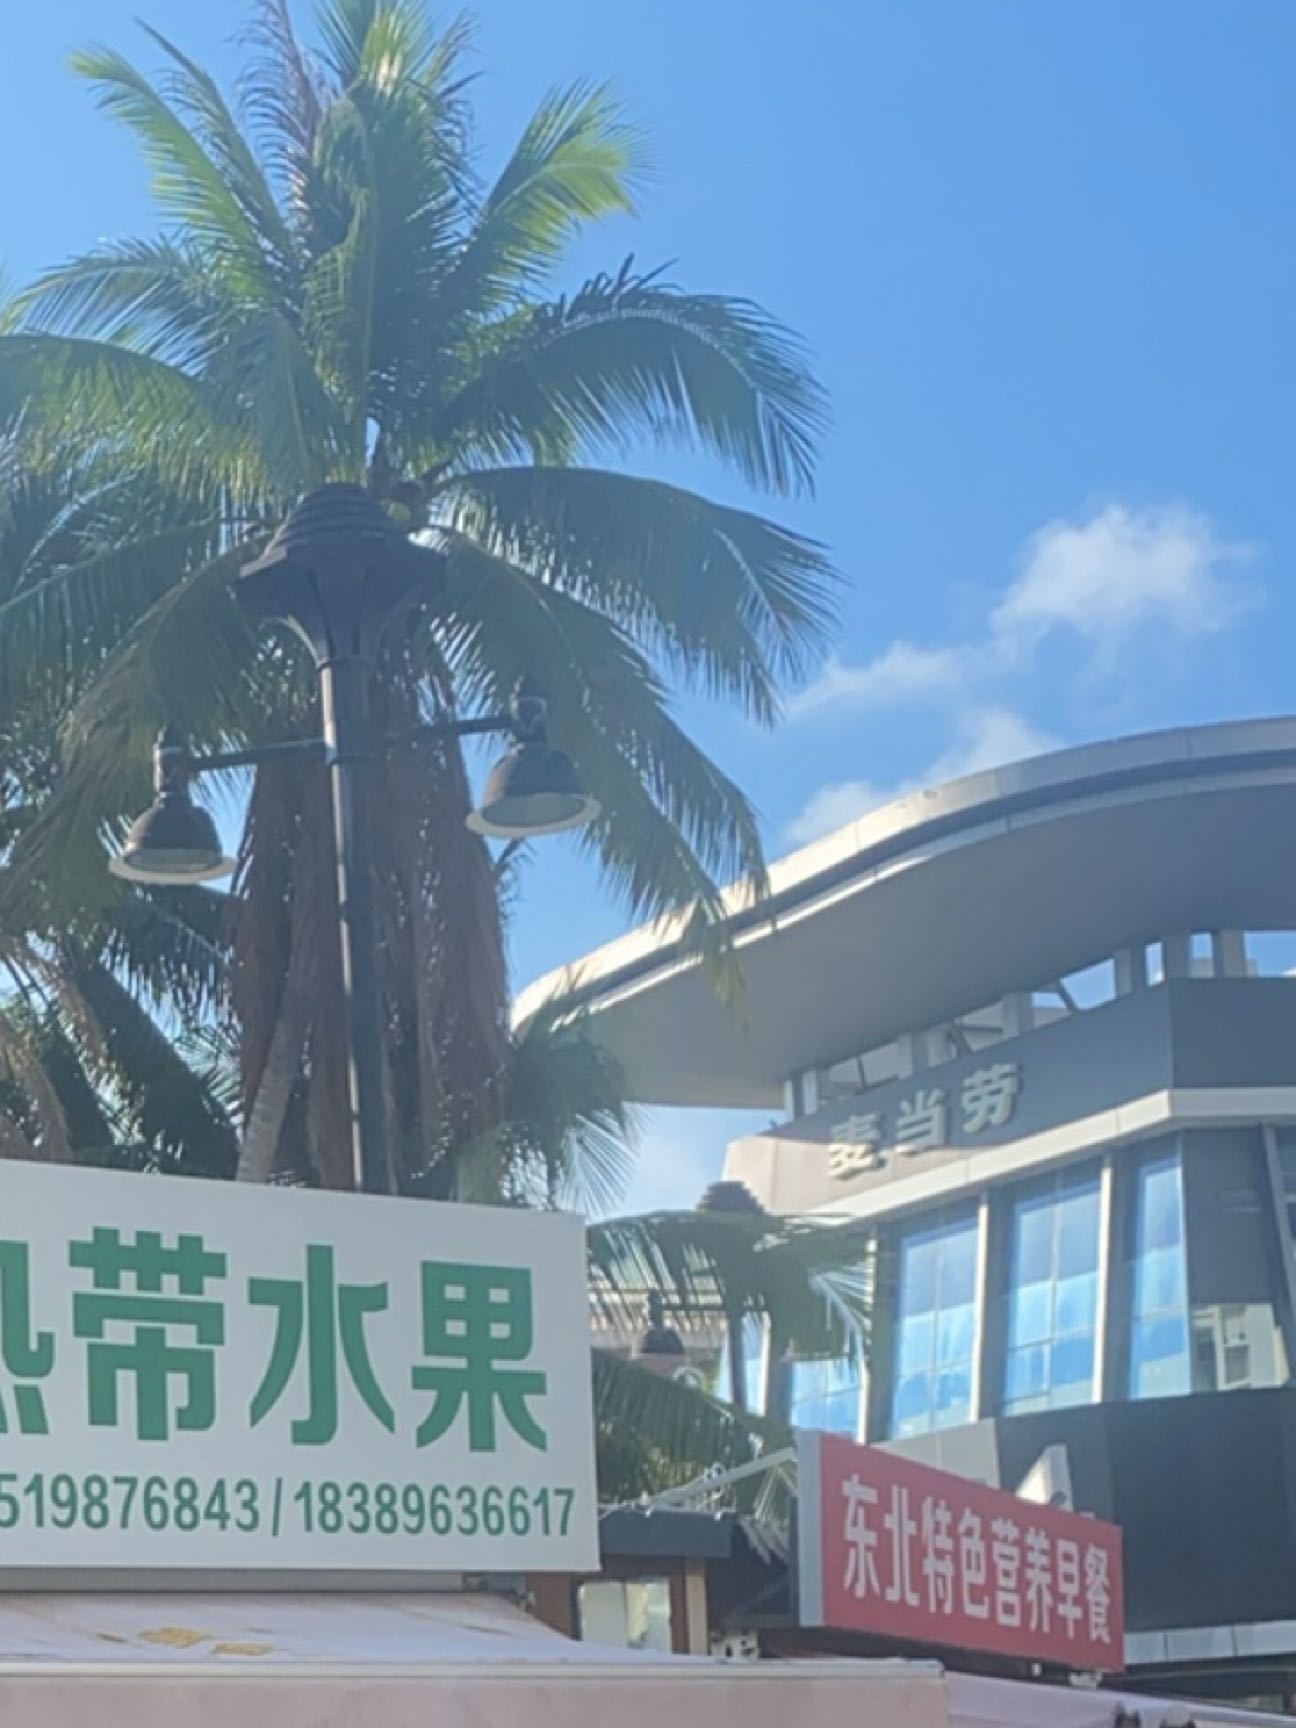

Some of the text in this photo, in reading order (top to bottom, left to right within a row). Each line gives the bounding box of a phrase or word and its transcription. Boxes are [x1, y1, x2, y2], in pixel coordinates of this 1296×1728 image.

[827, 1063, 1021, 1180] 麦当劳
[842, 1473, 1111, 1644] 东北特色营养早餐
